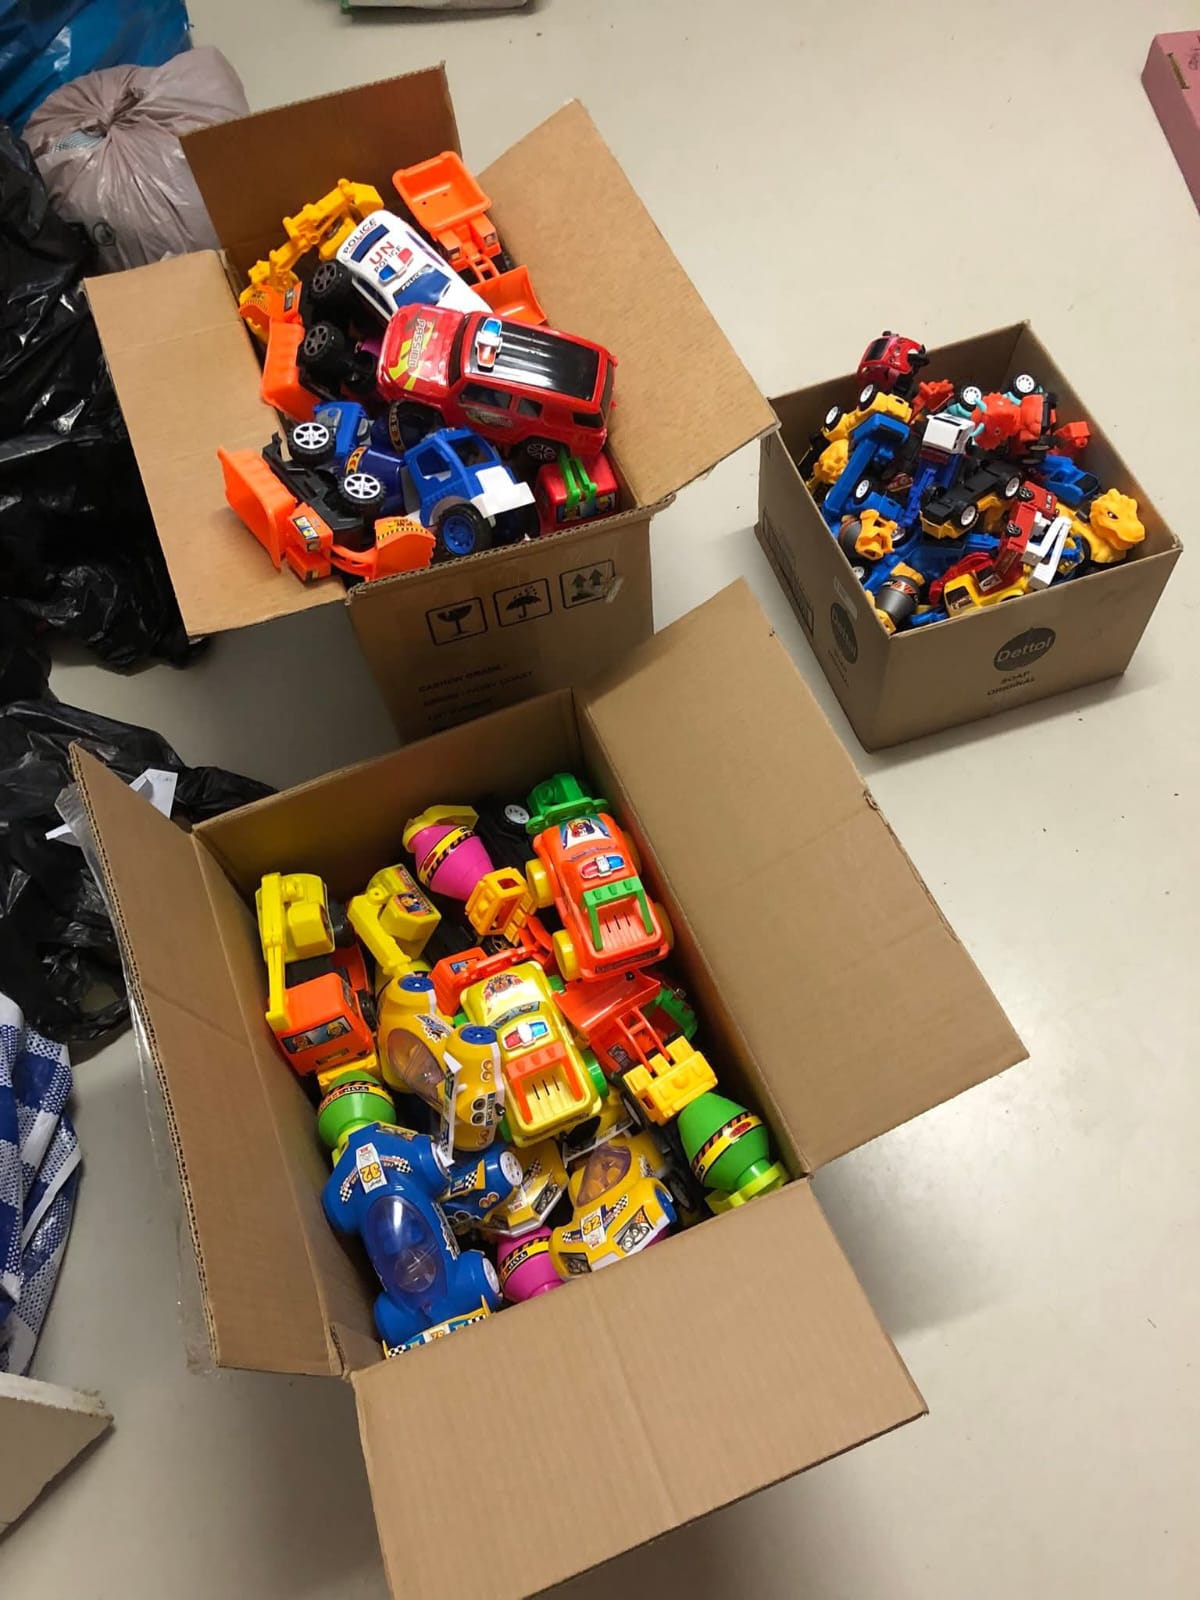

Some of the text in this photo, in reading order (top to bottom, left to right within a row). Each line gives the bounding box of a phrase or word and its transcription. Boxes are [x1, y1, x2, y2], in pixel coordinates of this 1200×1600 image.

[342, 218, 376, 254] POLICE
[369, 241, 395, 265] UN
[997, 636, 1052, 662] Dettol
